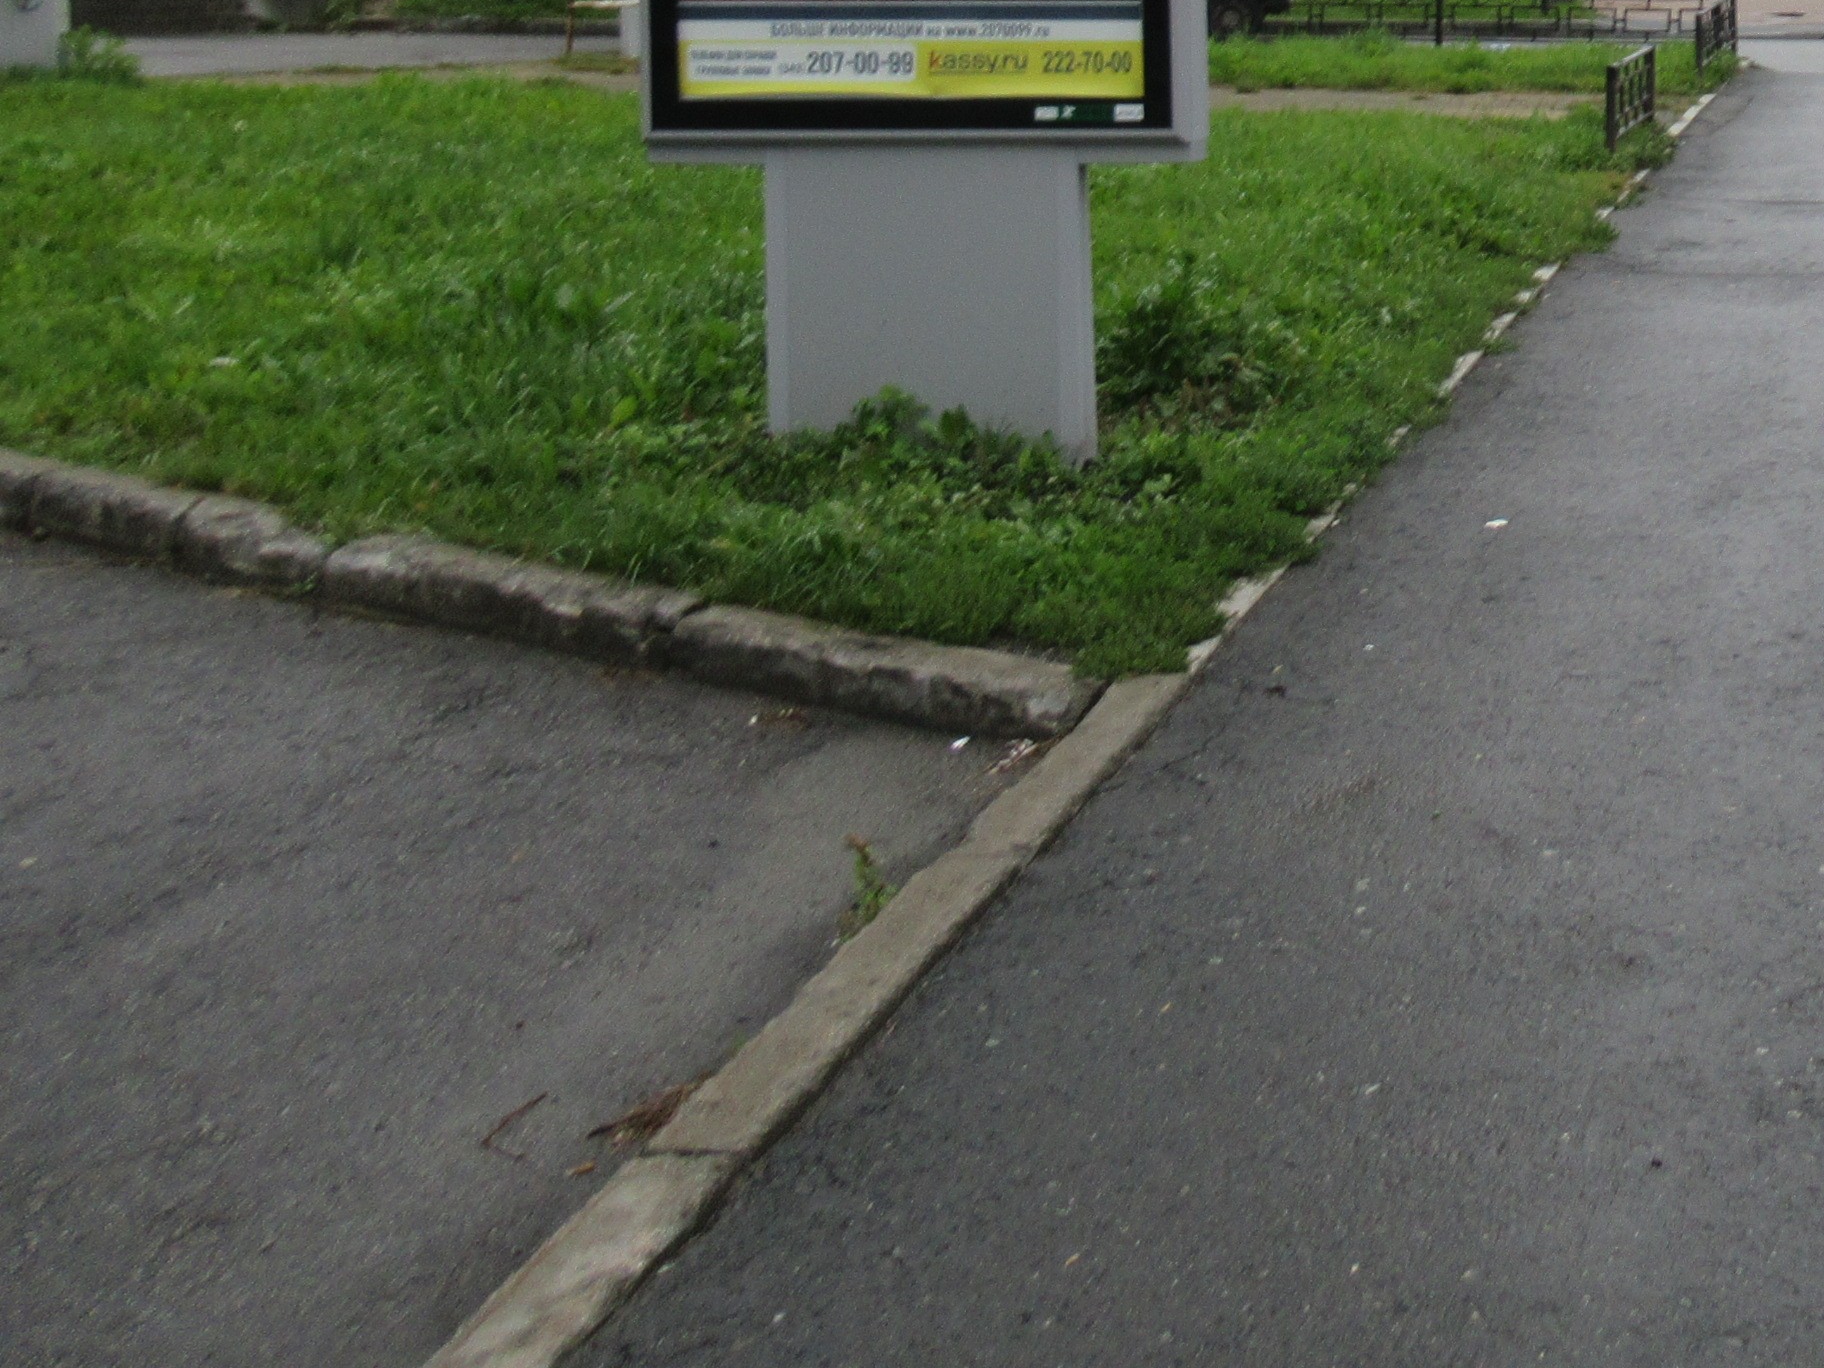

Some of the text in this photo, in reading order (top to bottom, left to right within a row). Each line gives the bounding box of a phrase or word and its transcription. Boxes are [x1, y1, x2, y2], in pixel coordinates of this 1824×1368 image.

[828, 21, 924, 38] ИНФОРМАЦИИ
[929, 50, 1133, 74] kassy.ru 222-70-00
